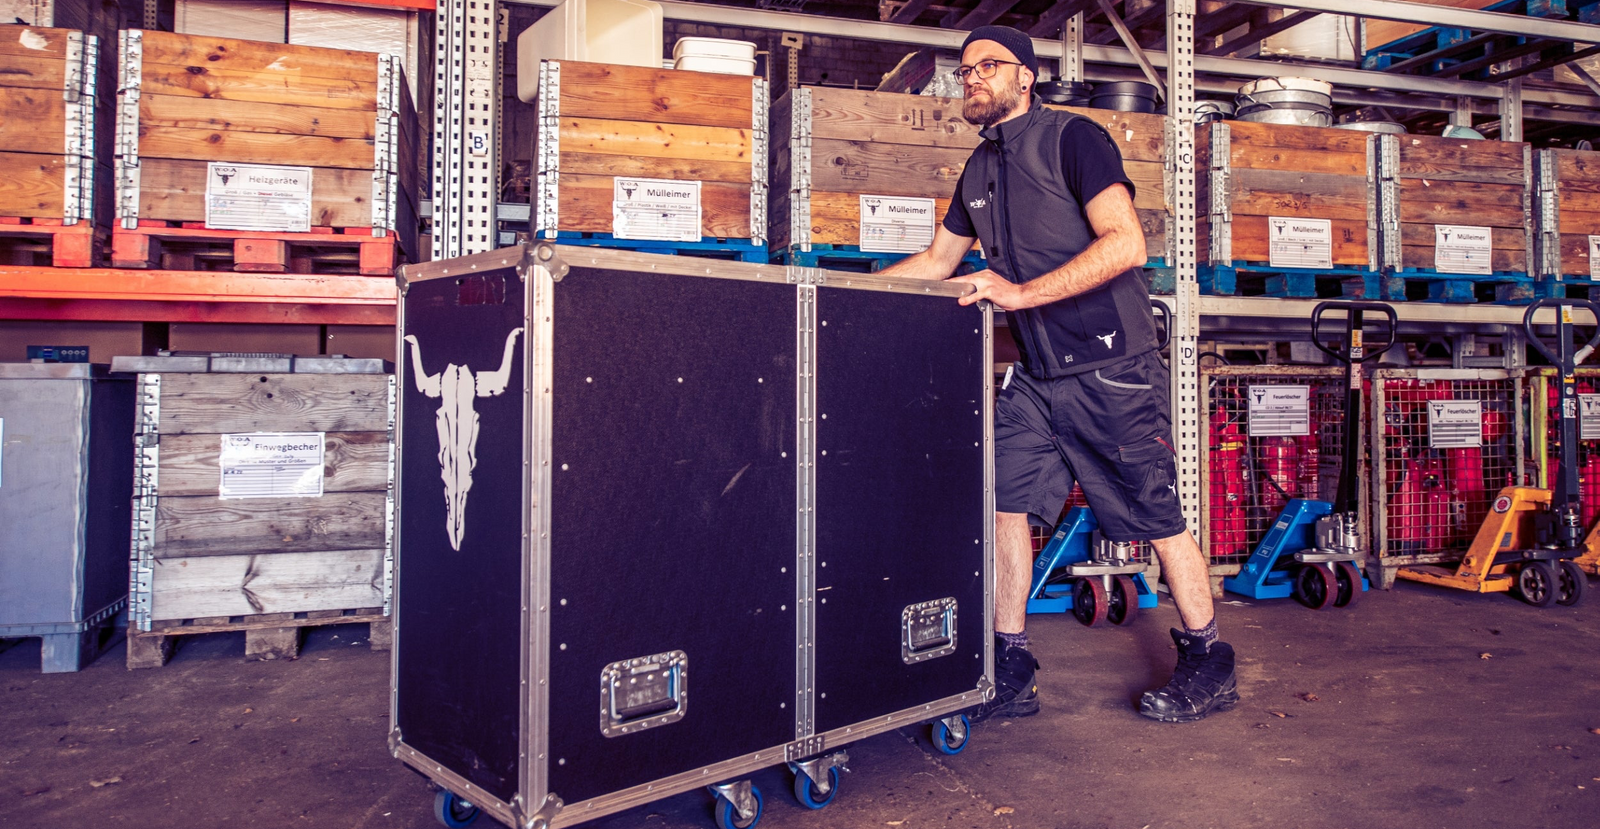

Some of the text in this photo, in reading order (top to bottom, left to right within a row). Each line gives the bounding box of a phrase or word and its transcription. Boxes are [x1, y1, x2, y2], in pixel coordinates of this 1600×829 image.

[474, 136, 484, 149] B
[1182, 153, 1190, 164] C
[248, 176, 298, 186] Heizgeräte
[646, 188, 691, 198] Mülleimer
[888, 206, 927, 214] Mülleimer
[1184, 348, 1192, 358] D
[255, 443, 318, 452] Einwegbecher
